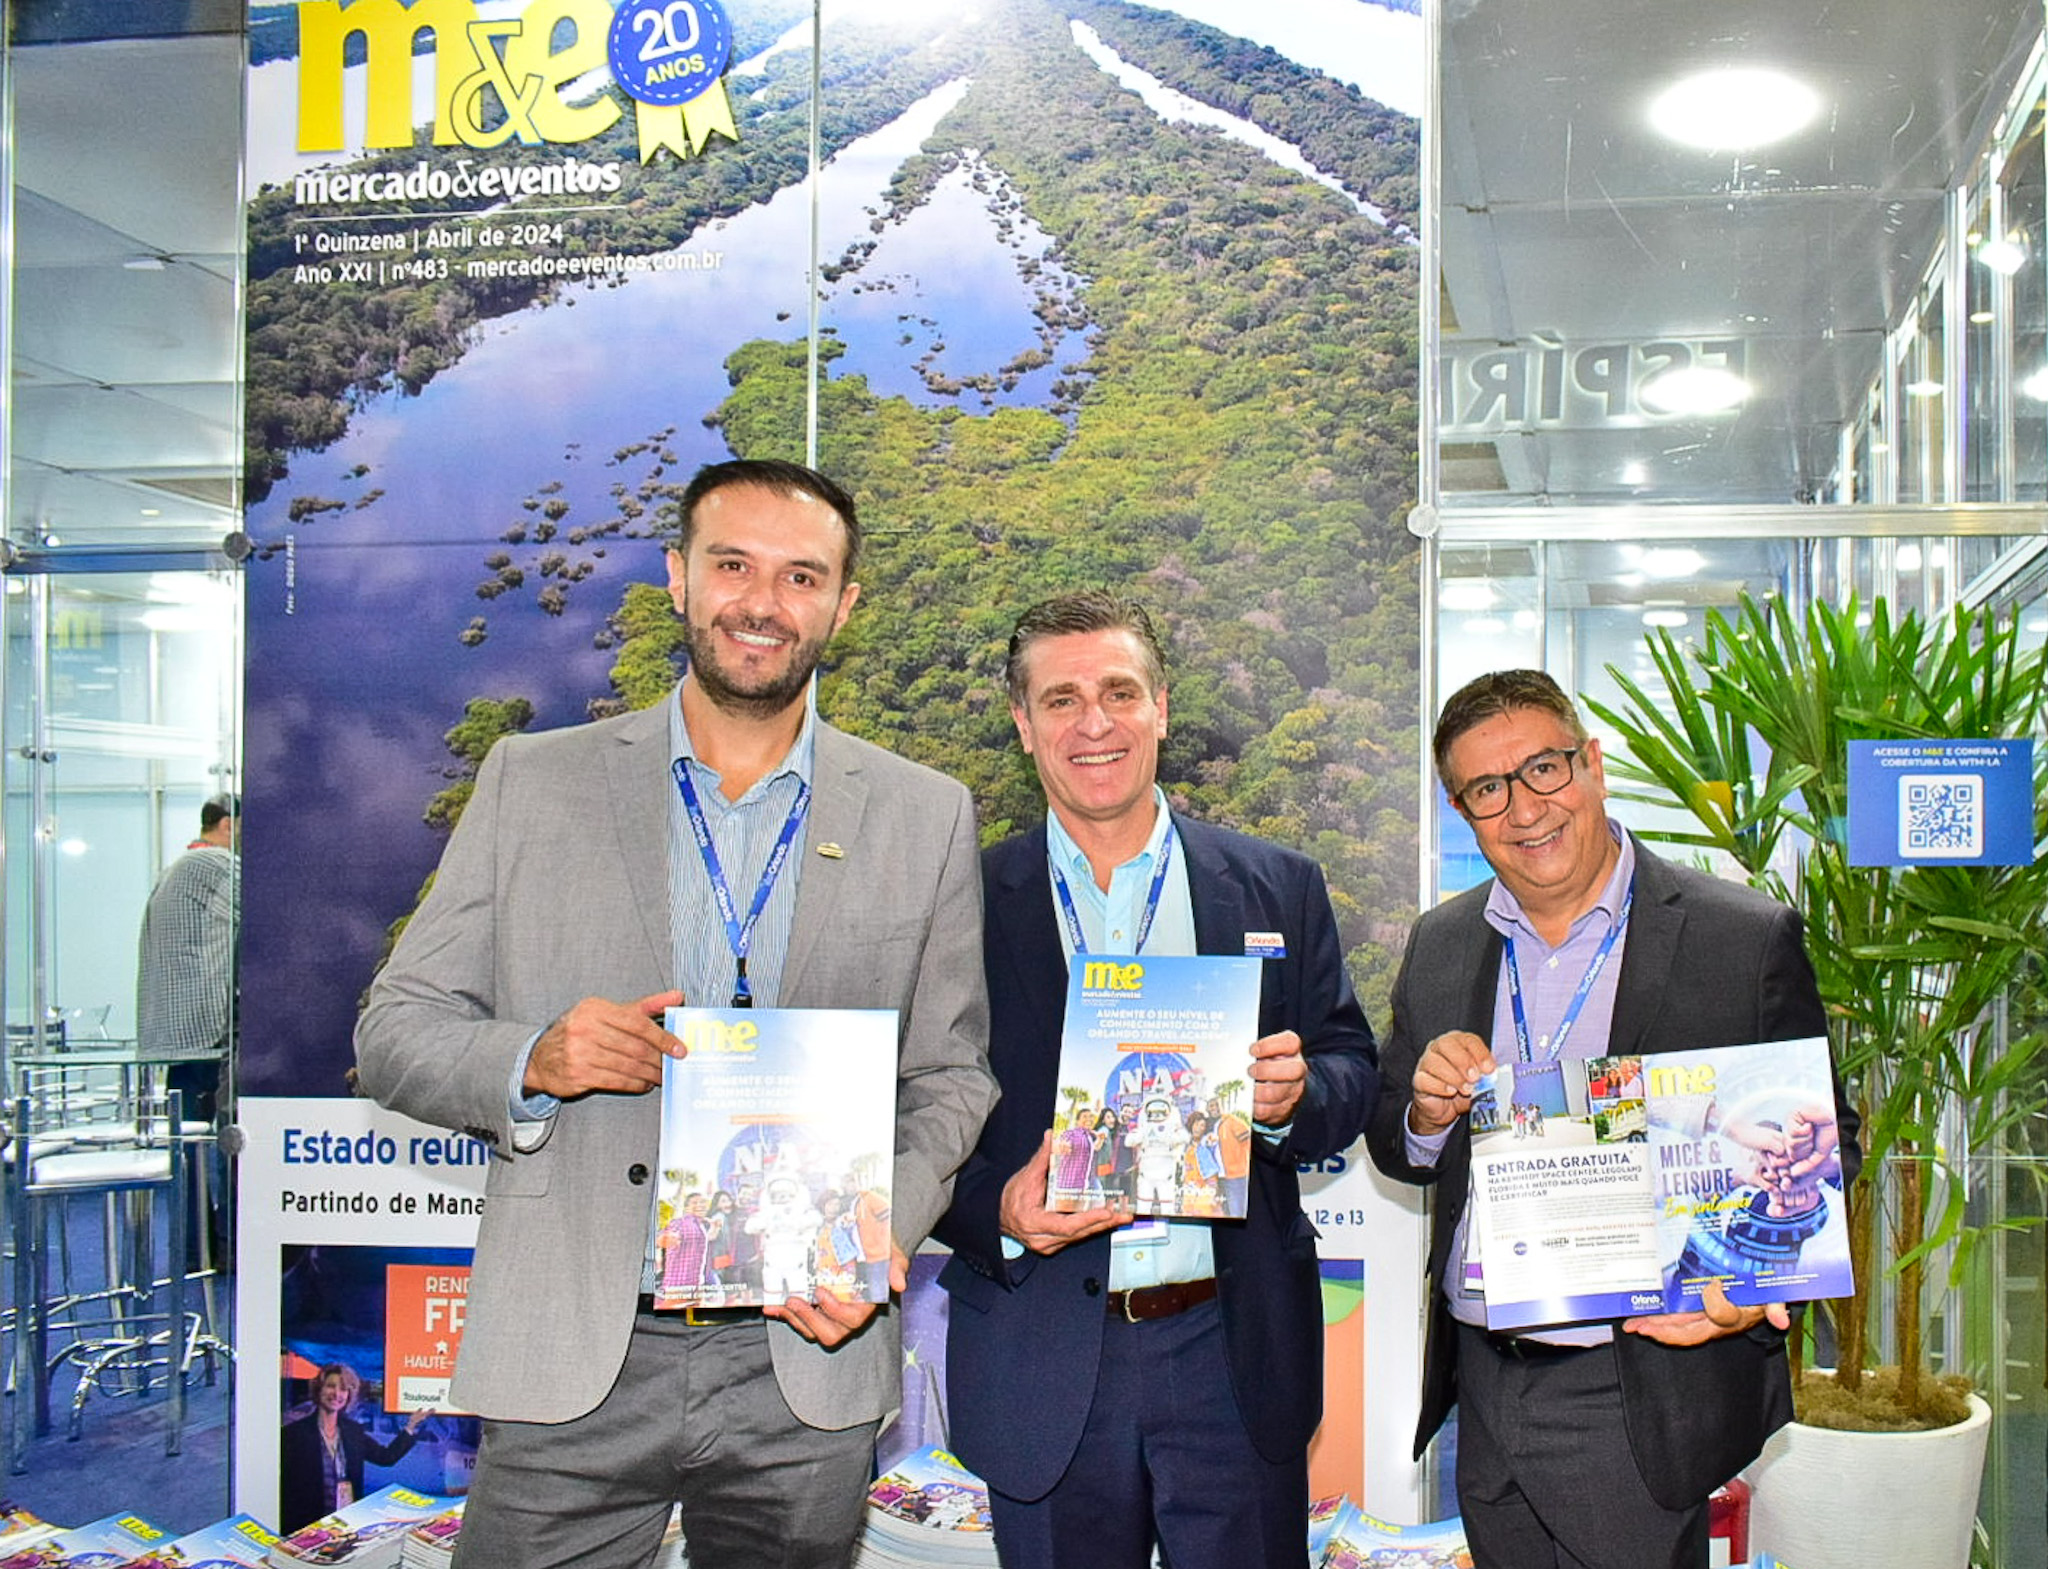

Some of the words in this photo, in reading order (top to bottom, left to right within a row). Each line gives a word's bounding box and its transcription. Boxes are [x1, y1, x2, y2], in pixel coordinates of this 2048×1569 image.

[632, 1, 699, 62] 20
[296, 0, 622, 152] m&e
[644, 53, 707, 86] ANOS
[295, 159, 622, 205] mercado&eventos
[315, 229, 406, 253] Quinzena
[426, 226, 473, 249] Abril
[479, 225, 505, 247] de
[511, 224, 564, 245] 2024
[294, 261, 332, 285] Ano
[338, 260, 371, 283] XXI
[467, 249, 723, 279] mercadoeeventos.com.br
[1873, 747, 1910, 756] ACESSE
[1912, 747, 1921, 756] O
[1946, 747, 1952, 756] E
[1954, 747, 1998, 756] CONFIRA
[1999, 747, 2008, 756] A
[1881, 758, 1941, 767] COBERTURA
[1943, 758, 1957, 767] DA
[1096, 1009, 1145, 1019] AUMENTE
[283, 1128, 397, 1165] Estado
[408, 1130, 492, 1166] reún
[1660, 1142, 1703, 1169] MICE
[1708, 1141, 1722, 1164] &
[1487, 1158, 1558, 1176] ENTRADA
[1560, 1152, 1630, 1169] GRATUITA
[1541, 1170, 1566, 1179] SPACE
[1560, 1178, 1580, 1187] MAIS
[1581, 1175, 1616, 1187] QUANDO
[1663, 1168, 1734, 1197] LEISURE
[281, 1190, 379, 1213] Partindo
[389, 1192, 417, 1214] de
[1315, 1210, 1329, 1225] 12
[1335, 1213, 1344, 1225] e
[1350, 1210, 1365, 1225] 13
[1630, 1294, 1661, 1306] Orlando
